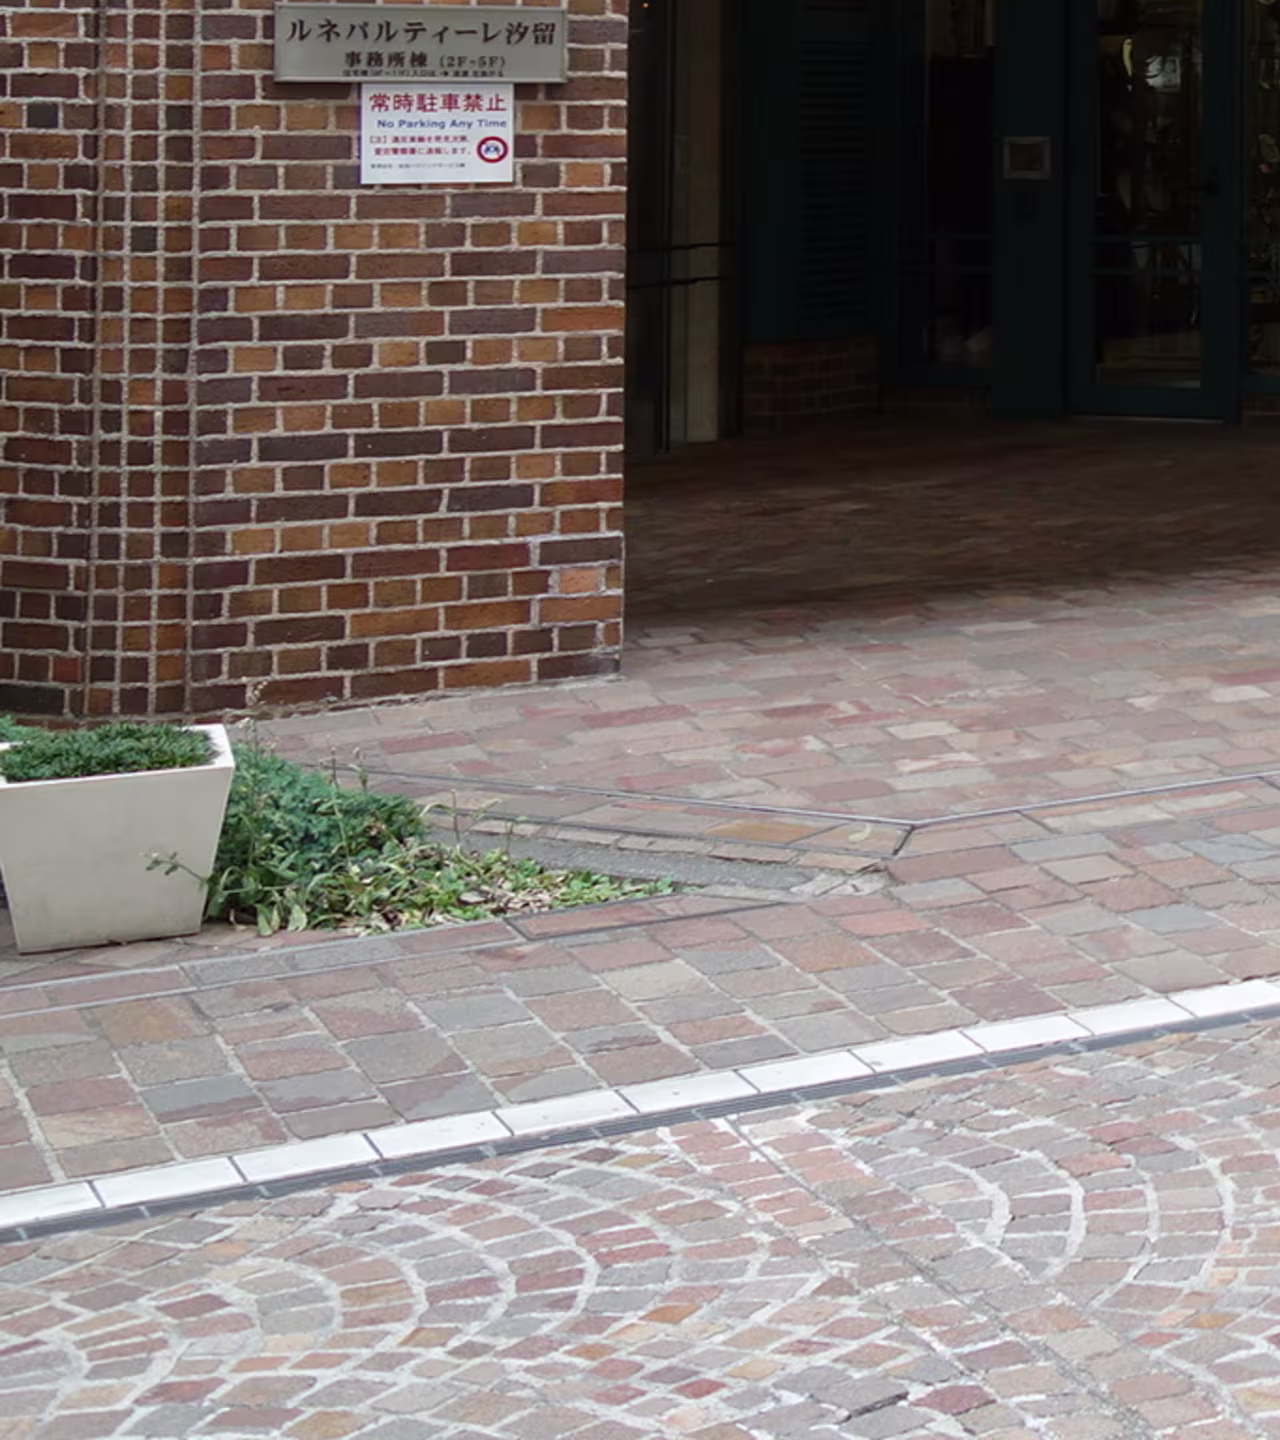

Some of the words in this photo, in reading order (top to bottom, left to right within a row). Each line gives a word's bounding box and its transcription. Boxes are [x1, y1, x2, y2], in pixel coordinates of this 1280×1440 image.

[369, 92, 507, 113] 常時駐車禁止
[377, 120, 395, 128] No
[398, 120, 446, 130] Parking
[449, 120, 474, 130] Any
[477, 119, 507, 128] Time
